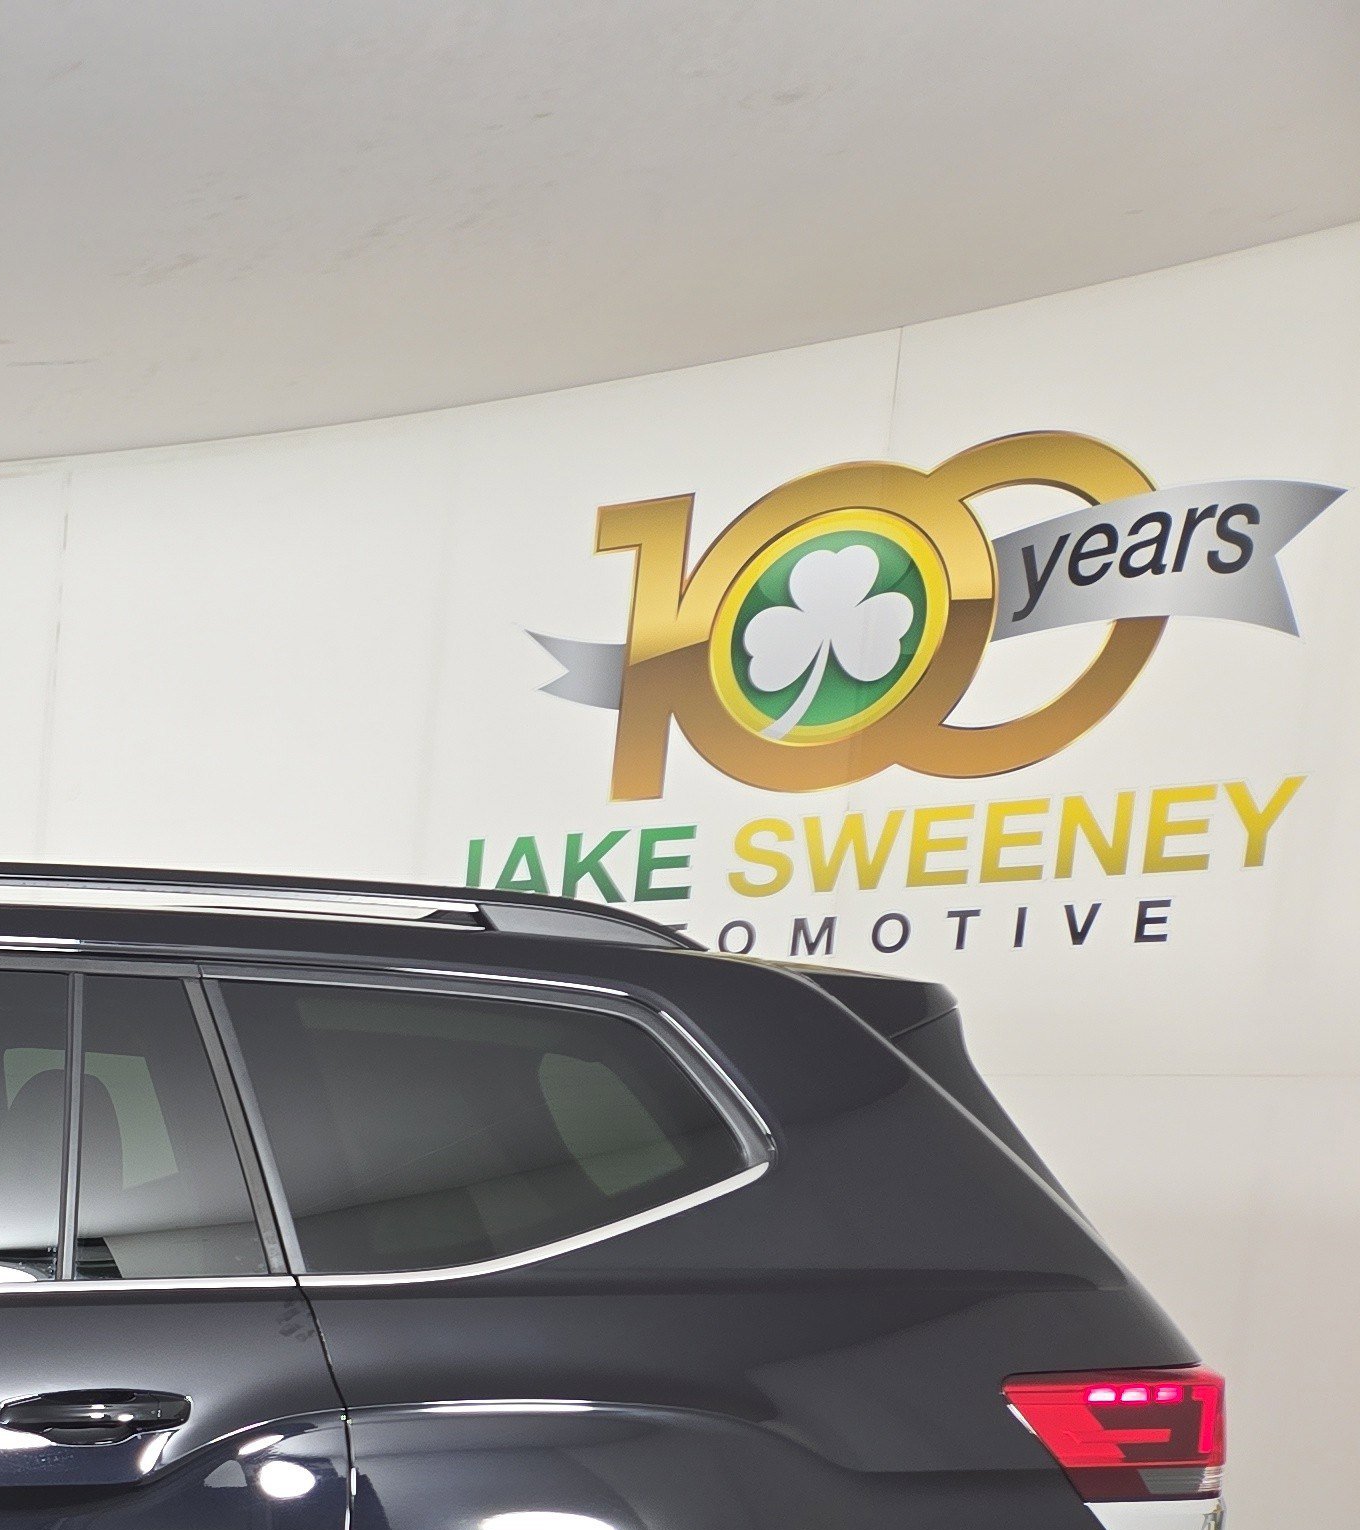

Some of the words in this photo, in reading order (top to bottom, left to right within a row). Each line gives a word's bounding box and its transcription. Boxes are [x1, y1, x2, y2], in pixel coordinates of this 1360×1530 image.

[593, 430, 1169, 803] 100
[1011, 501, 1261, 623] years
[727, 775, 1308, 899] SWEENEY
